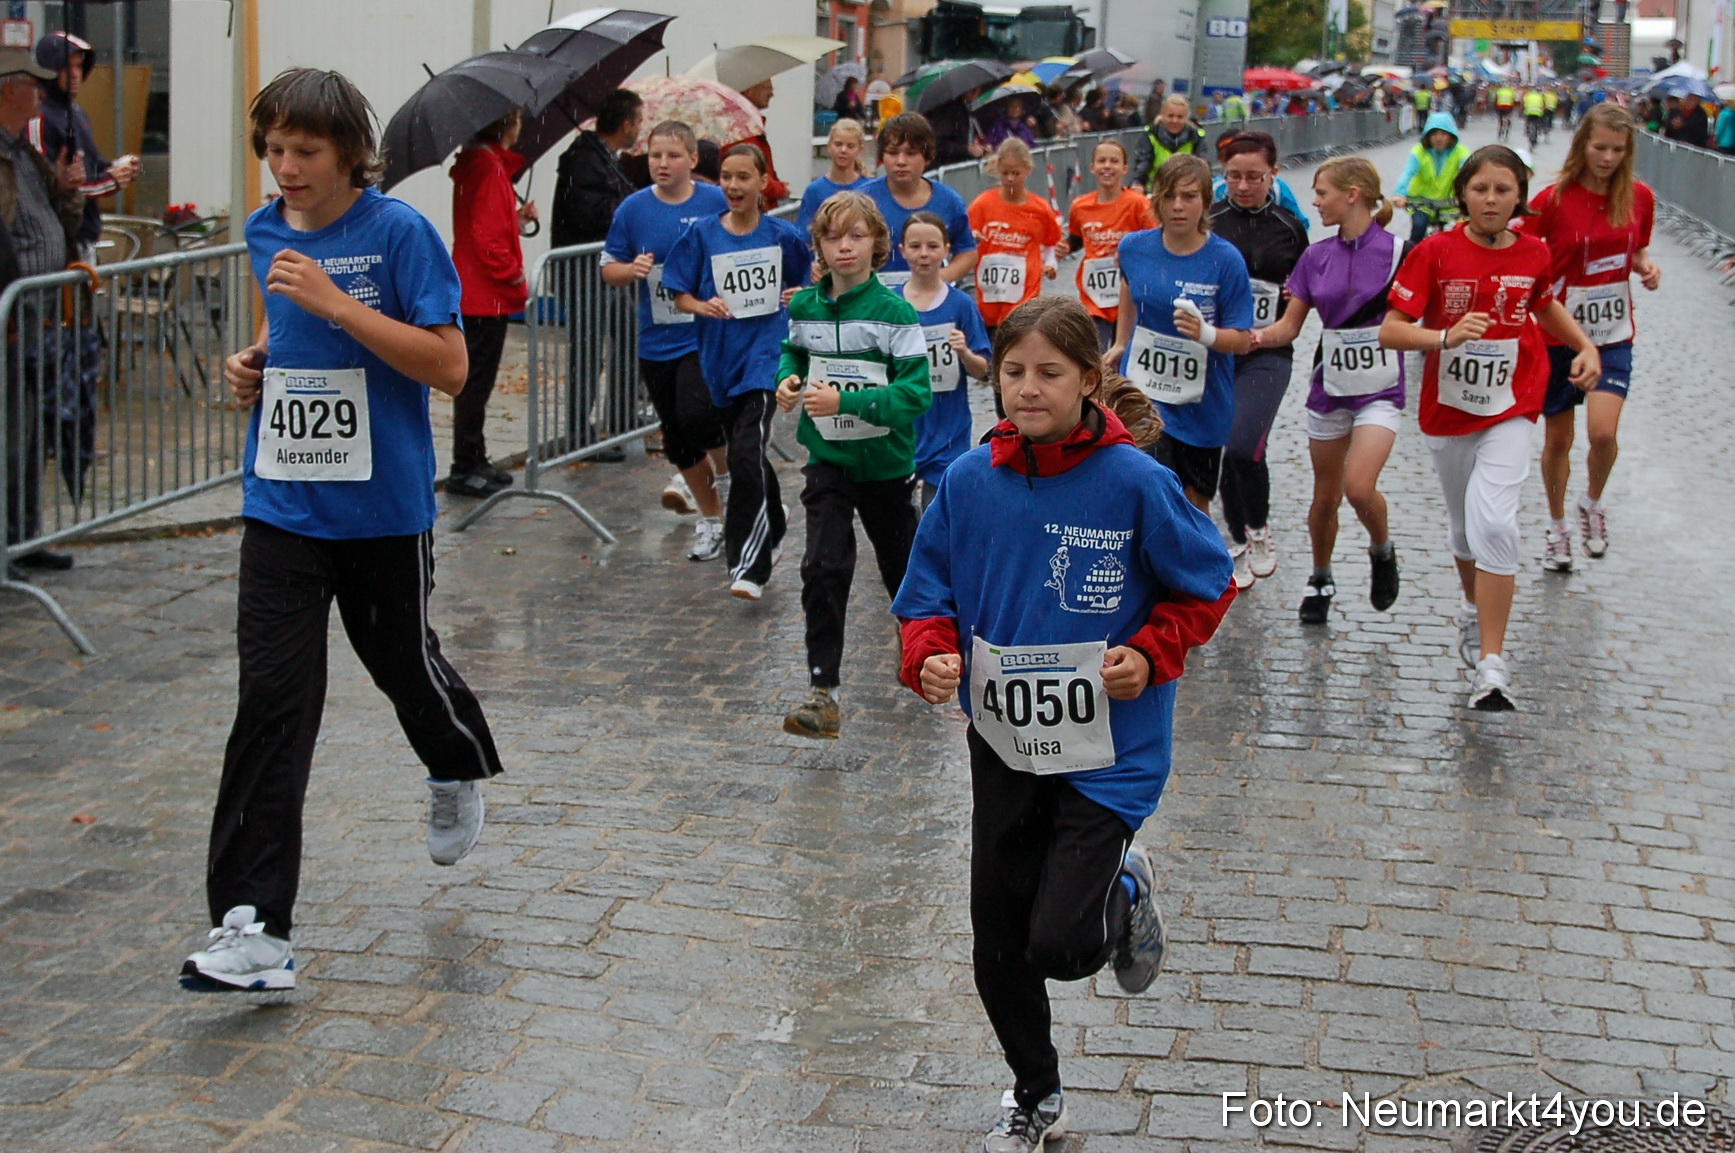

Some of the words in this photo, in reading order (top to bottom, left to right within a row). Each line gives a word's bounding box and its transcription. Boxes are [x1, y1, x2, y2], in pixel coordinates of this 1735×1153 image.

[324, 255, 383, 267] NEUMARKTER
[723, 265, 777, 294] 4034
[982, 266, 1020, 285] 4078
[1087, 270, 1118, 290] 407
[743, 297, 766, 308] Jana
[1256, 297, 1270, 320] 8
[1573, 298, 1624, 324] 4049
[927, 341, 953, 367] 13
[1330, 345, 1387, 371] 4091
[1137, 348, 1198, 381] 4019
[1447, 356, 1510, 387] 4015
[285, 376, 328, 389] BOCK
[1145, 378, 1182, 394] Jasmin
[270, 398, 358, 440] 4029
[832, 416, 855, 429] Tim
[276, 448, 349, 465] Alexander
[1043, 523, 1063, 535] 12.
[1060, 535, 1124, 551] STADTLAUF
[1082, 583, 1124, 594] 18.09.2011
[1001, 652, 1060, 667] BOCK
[982, 677, 1096, 727] 4050
[1013, 736, 1062, 756] Luisa
